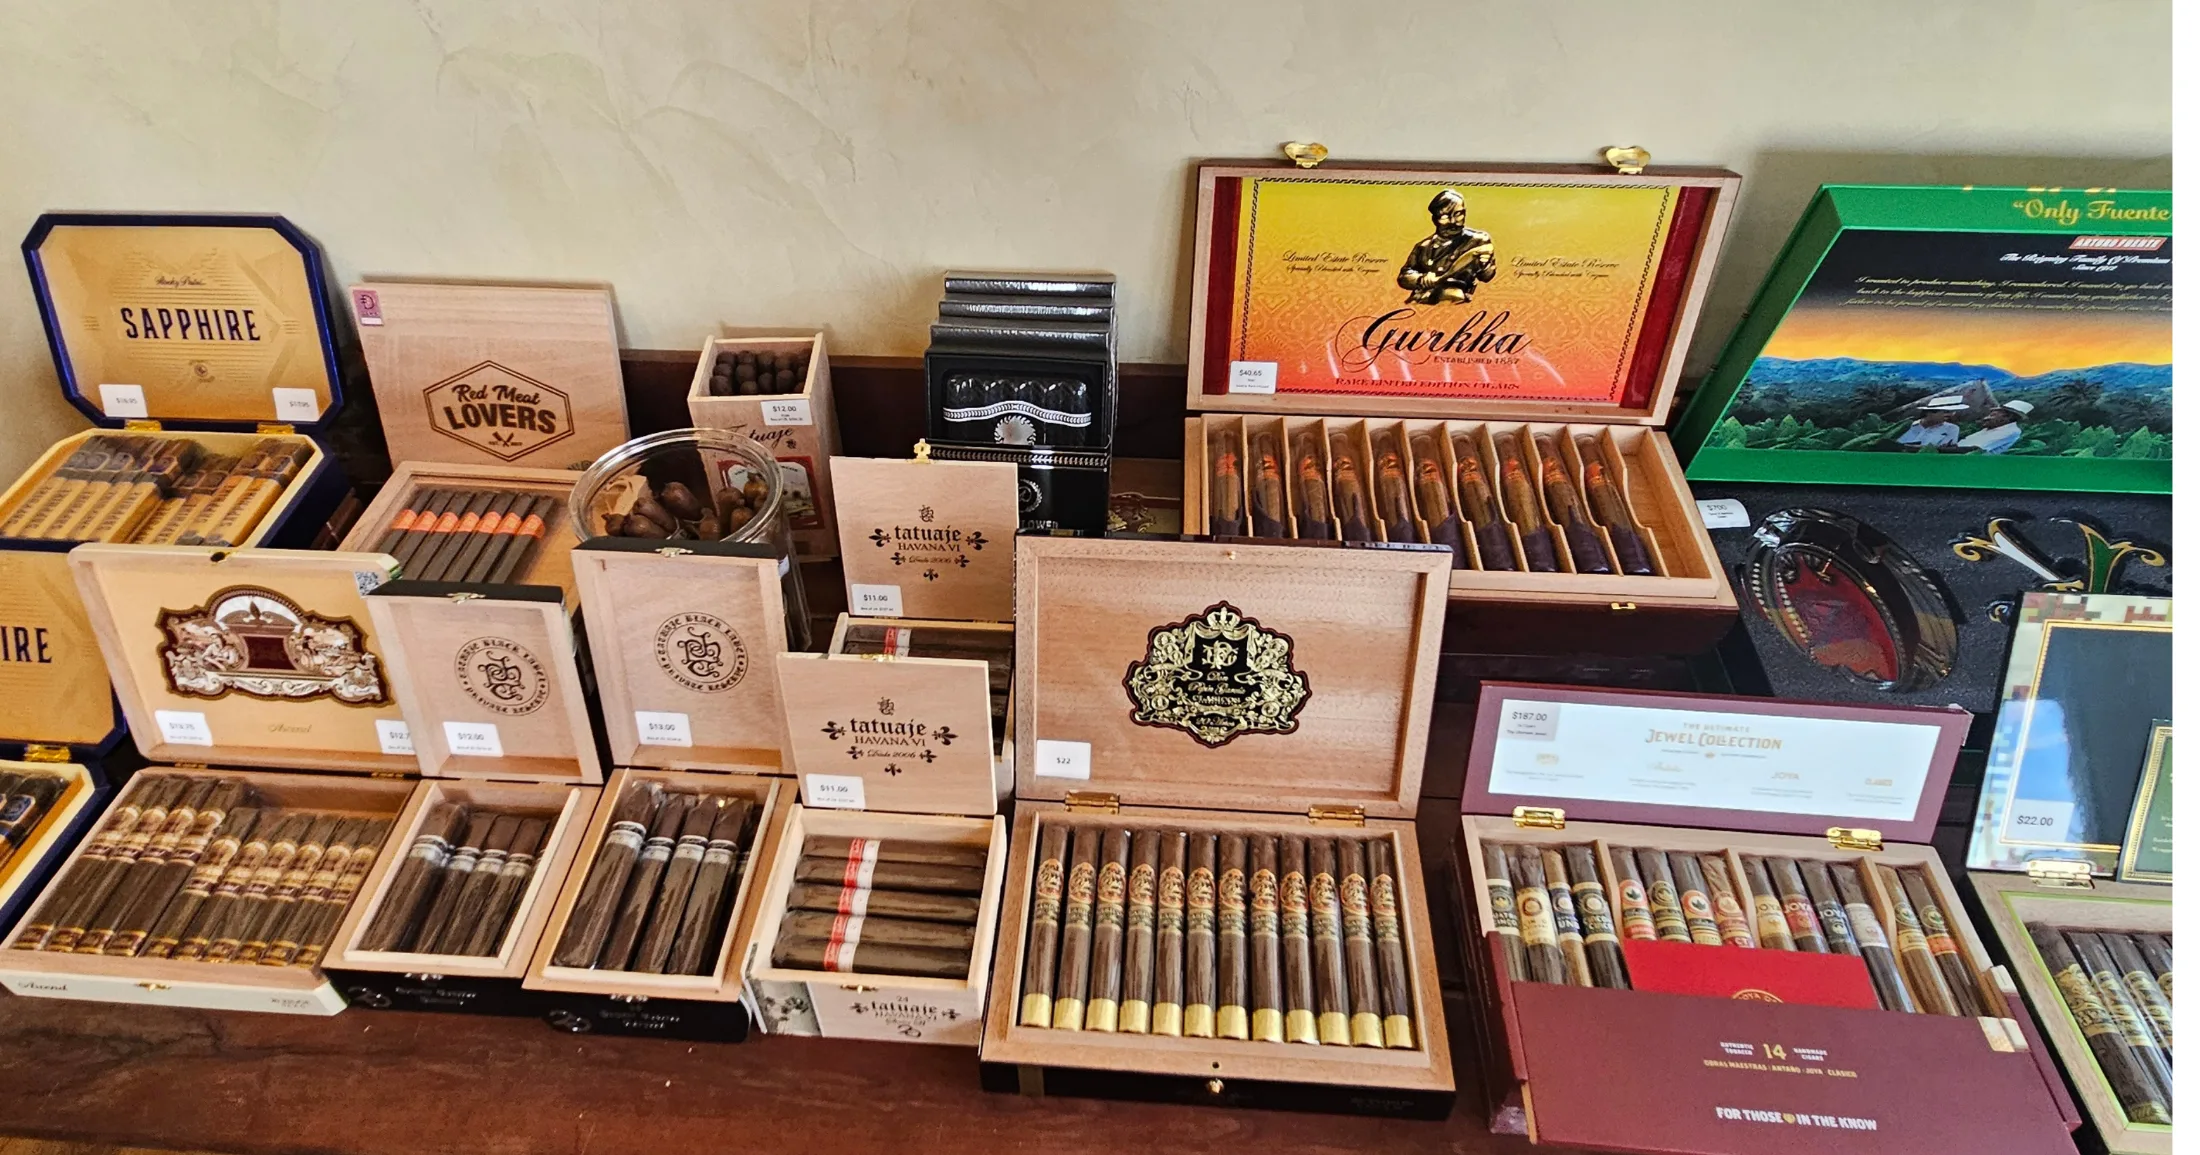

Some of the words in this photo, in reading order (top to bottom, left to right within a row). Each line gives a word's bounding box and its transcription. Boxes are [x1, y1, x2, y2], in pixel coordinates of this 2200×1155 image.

[2087, 200, 2172, 221] Fuente
[2074, 238, 2118, 247] ARTURO
[2118, 239, 2162, 248] FUENTE
[1282, 251, 1319, 262] Limited
[1321, 252, 1350, 262] Estate
[1352, 253, 1388, 264] Reserve
[1511, 256, 1549, 267] Limited
[1550, 257, 1579, 268] Estate
[1581, 258, 1620, 268] Reserve
[121, 307, 260, 341] SAPPHIRE
[1336, 308, 1532, 373] Gurkha
[1434, 355, 1492, 365] ESTABLISHED
[1335, 377, 1374, 386] RARE
[1420, 380, 1470, 388] EDITION
[452, 384, 488, 402] Red
[492, 385, 541, 405] Meat
[444, 403, 556, 434] LOVERS
[1021, 519, 1059, 530] LOWER
[895, 525, 961, 544] tatuaje
[898, 543, 946, 551] HAVANA
[950, 544, 960, 552] VI
[1512, 711, 1548, 721] $187.00
[850, 718, 927, 738] tatuaje
[1683, 722, 1700, 730] THE
[1704, 723, 1750, 733] ULTIMATE
[389, 731, 411, 740] $12.7
[855, 736, 909, 746] HAVANA
[913, 738, 926, 747] VI
[1645, 729, 1695, 744] JEWEL
[1698, 732, 1783, 750] COLLECTION
[893, 750, 916, 759] 2006
[2017, 815, 2054, 826] $22.00
[872, 1001, 937, 1015] tatuaje
[1763, 1043, 1787, 1060] 14
[1793, 1047, 1828, 1056] HANDMADE
[1703, 1059, 1728, 1068] OBRAS
[1729, 1061, 1767, 1071] MAESTRAS
[1805, 1067, 1823, 1075] JOYA
[1715, 1106, 1742, 1119] FOR
[1742, 1109, 1783, 1123] THOSE
[1795, 1113, 1811, 1126] IN
[1811, 1115, 1838, 1128] THE
[1838, 1117, 1877, 1130] KNOW
